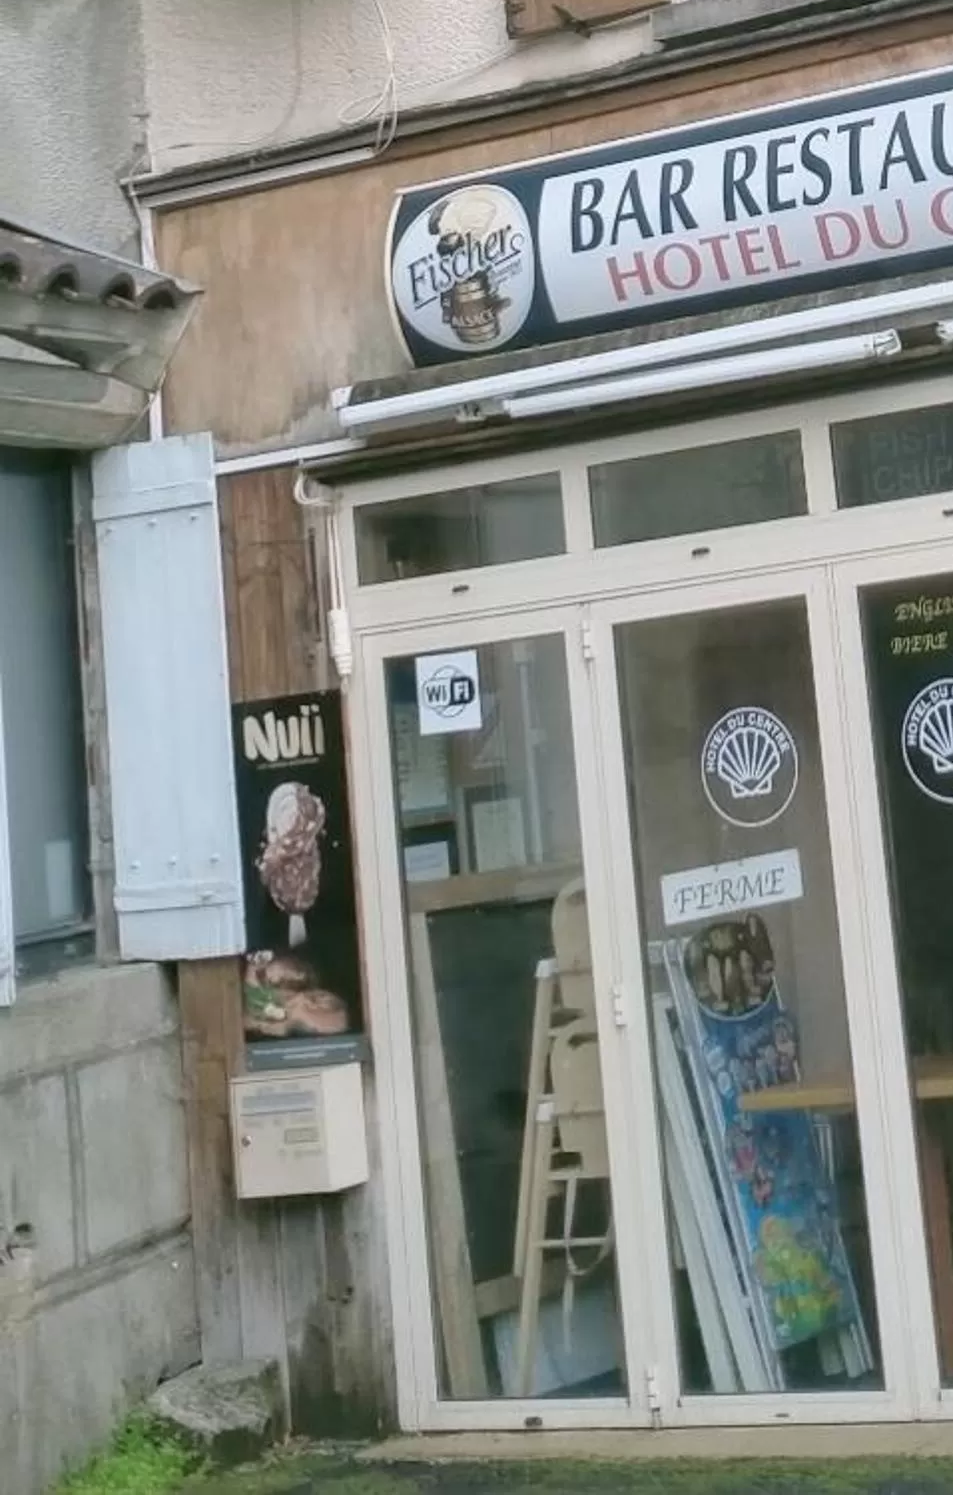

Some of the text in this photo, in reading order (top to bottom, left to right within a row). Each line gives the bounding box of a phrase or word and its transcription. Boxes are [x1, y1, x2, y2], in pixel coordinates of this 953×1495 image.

[571, 158, 699, 254] BAR
[407, 224, 514, 305] Fischer
[606, 224, 801, 302] HOTEL
[815, 199, 910, 261] DU
[891, 632, 948, 654] BIERE
[243, 704, 325, 762] Nuii
[706, 712, 790, 773] HOTEL DU CENTRE
[906, 699, 932, 746] HOTEL
[929, 684, 948, 704] DU
[673, 866, 786, 914] FERME
